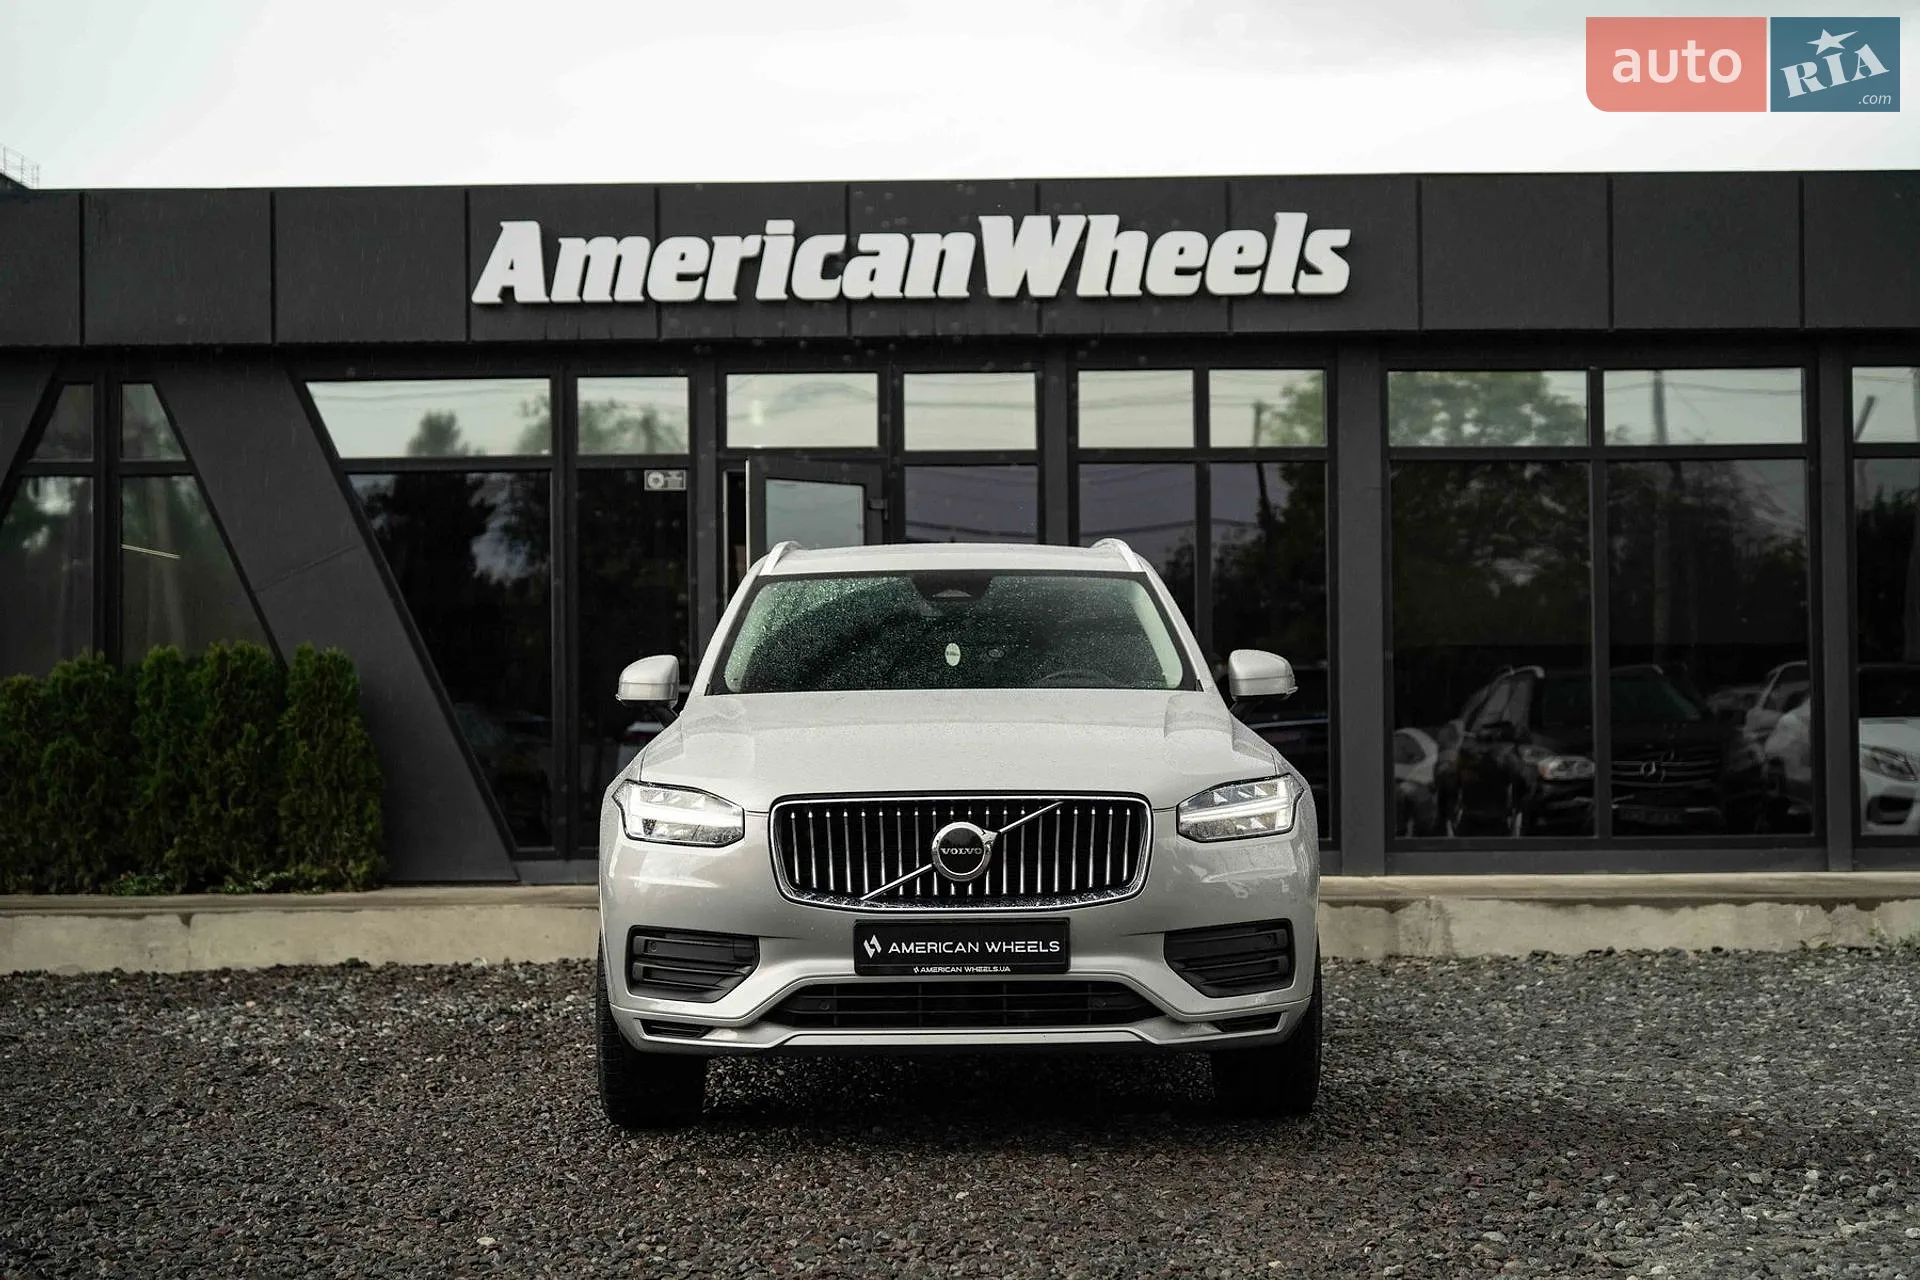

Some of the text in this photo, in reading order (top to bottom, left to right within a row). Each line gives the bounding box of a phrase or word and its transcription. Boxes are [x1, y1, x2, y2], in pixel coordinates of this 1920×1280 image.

[940, 847, 983, 855] VOLVO
[888, 940, 1060, 954] AMERICAN WHEELS
